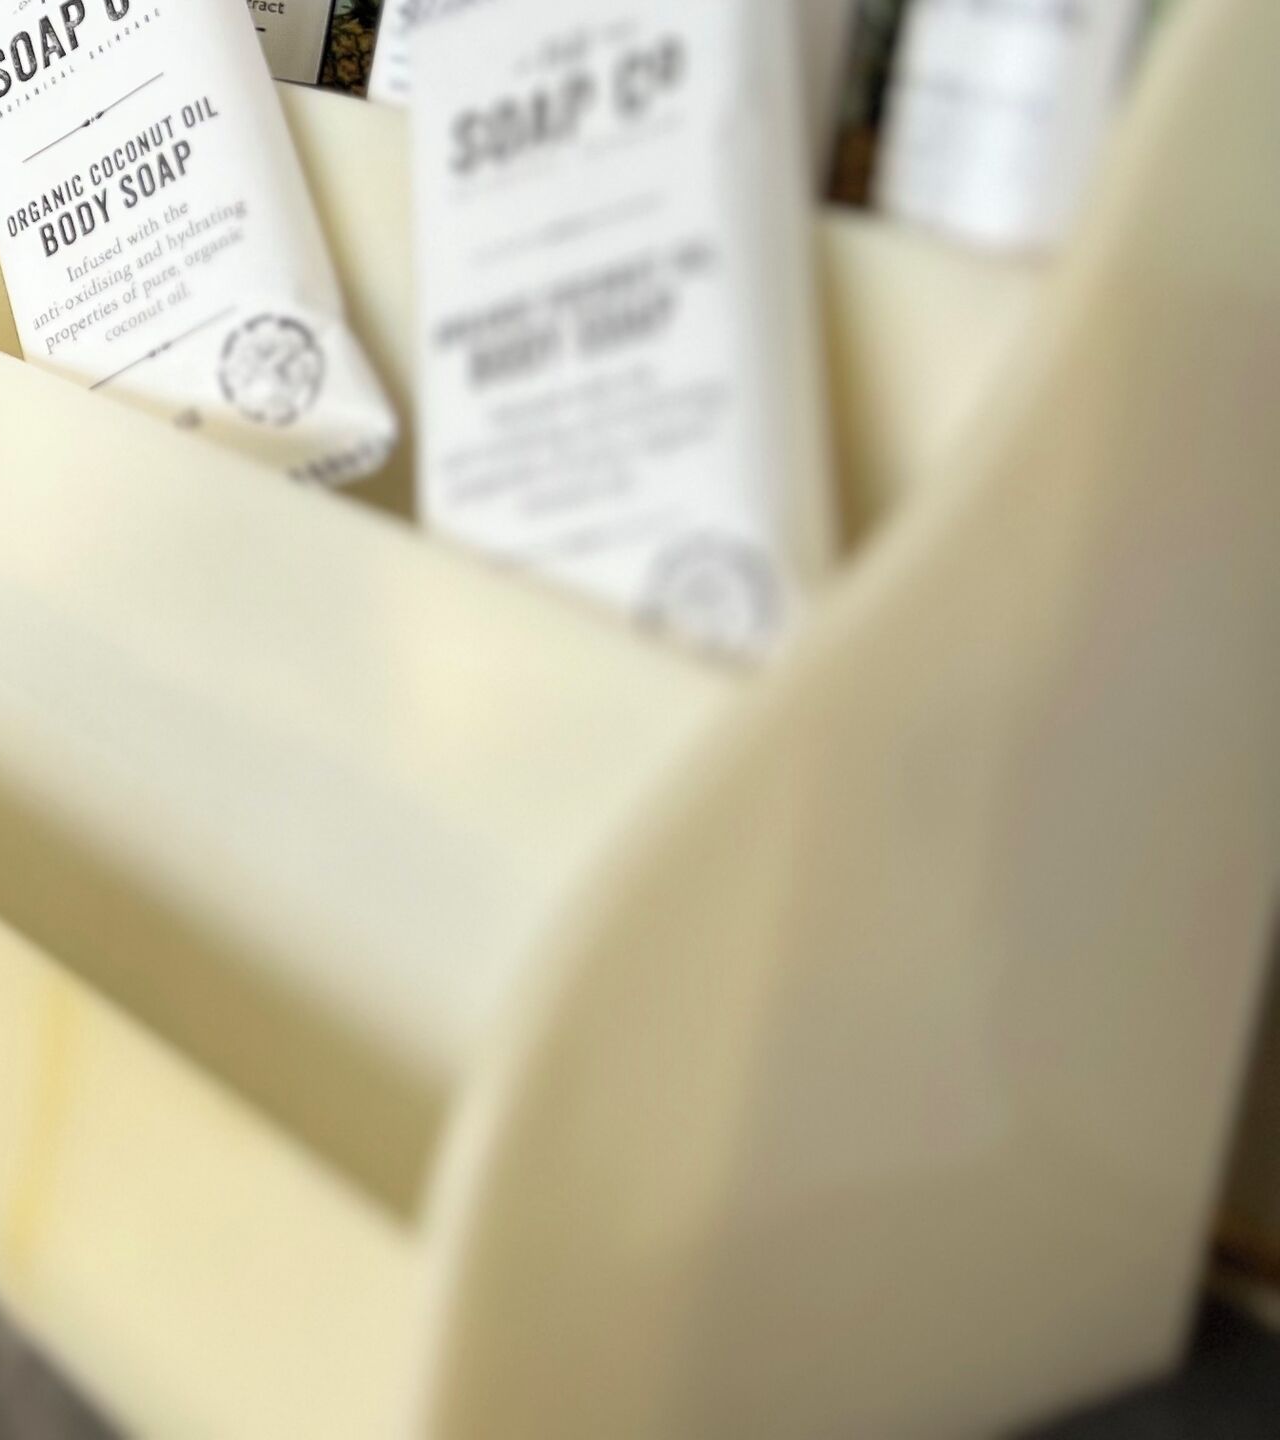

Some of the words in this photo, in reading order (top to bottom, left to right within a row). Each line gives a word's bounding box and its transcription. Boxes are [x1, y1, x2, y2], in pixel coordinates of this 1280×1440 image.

[7, 175, 85, 237] ORGANIC
[90, 115, 174, 186] COCONUT
[181, 96, 218, 129] OIL
[39, 189, 110, 257] BODY
[119, 140, 191, 208] SOAP
[32, 264, 134, 330] anti-oxidising
[137, 242, 162, 269] and
[166, 200, 247, 252] hydrating
[44, 299, 119, 354] properties
[122, 283, 139, 305] of
[184, 228, 243, 268] organic
[66, 238, 122, 283] Infused
[126, 217, 160, 246] with
[164, 202, 188, 224] the
[104, 299, 163, 342] coconut
